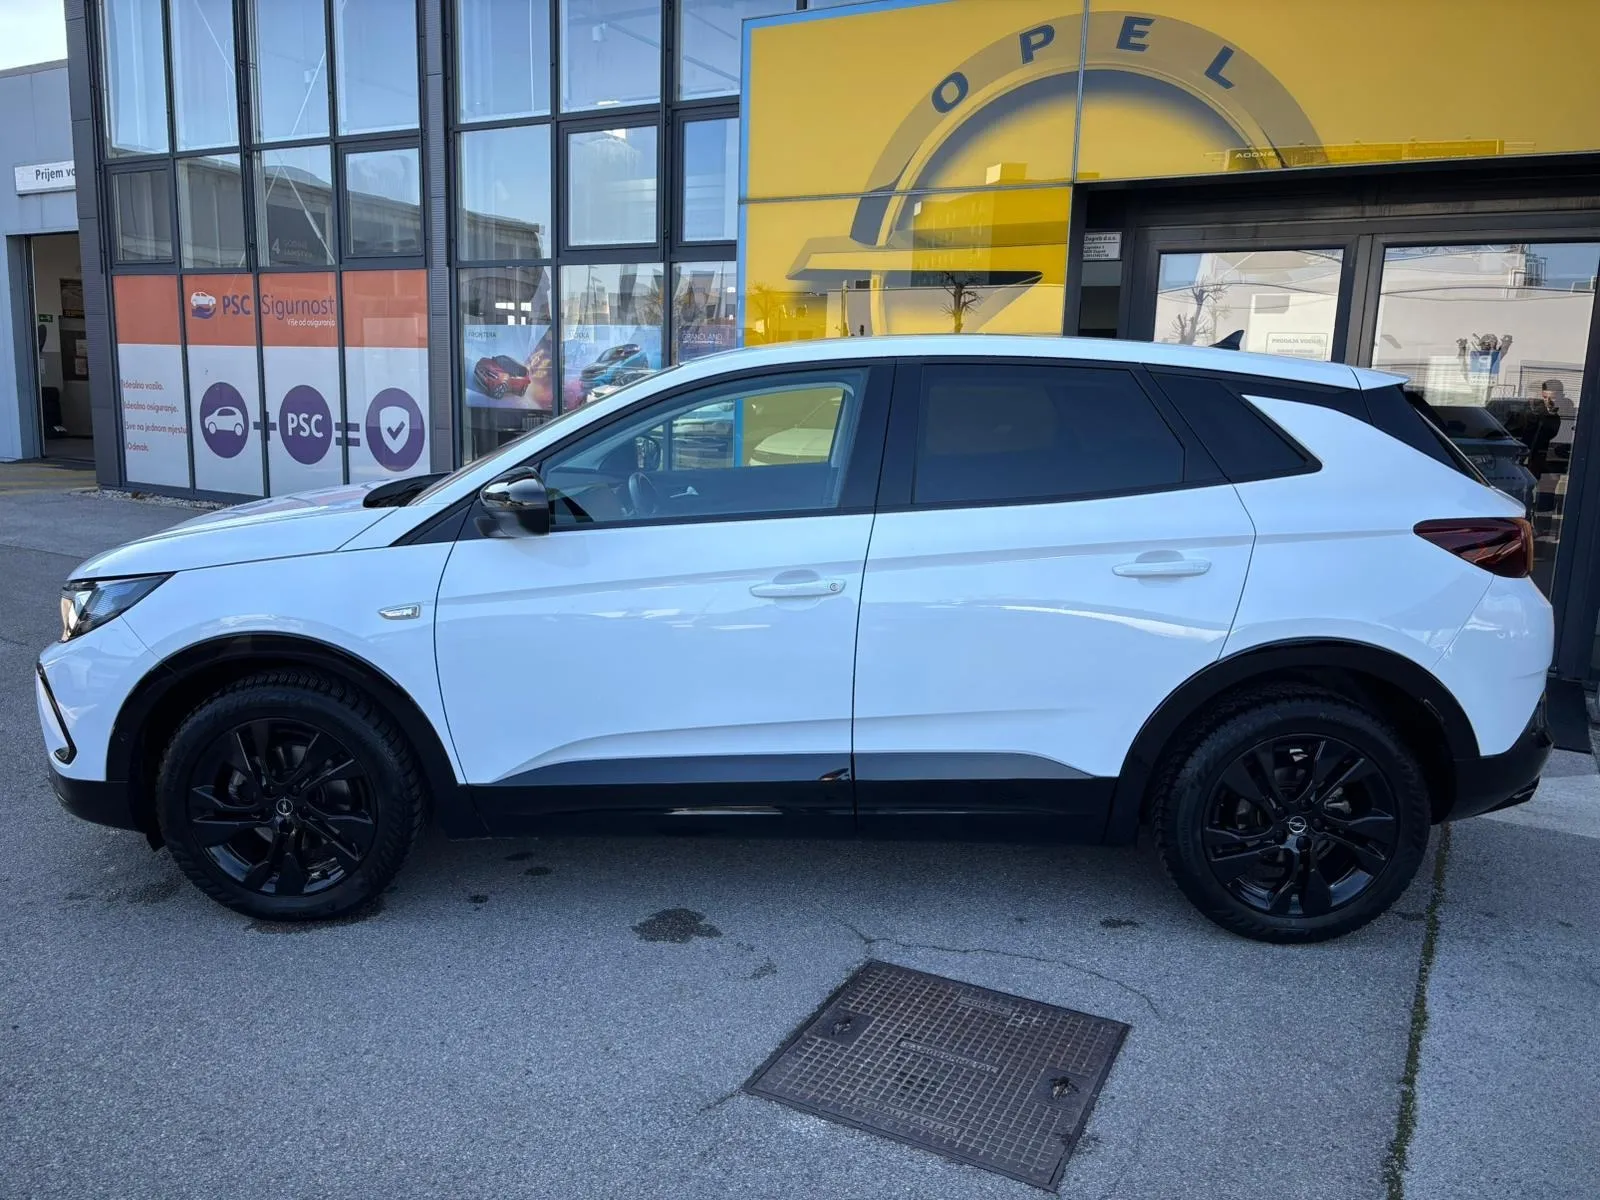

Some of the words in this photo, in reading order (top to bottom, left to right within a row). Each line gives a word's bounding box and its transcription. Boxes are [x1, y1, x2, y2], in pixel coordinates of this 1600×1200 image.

[931, 15, 1236, 113] OPEL
[35, 168, 64, 182] Prijem
[222, 295, 250, 315] PSC
[261, 294, 335, 320] Sigurnost
[287, 412, 324, 438] PSC
